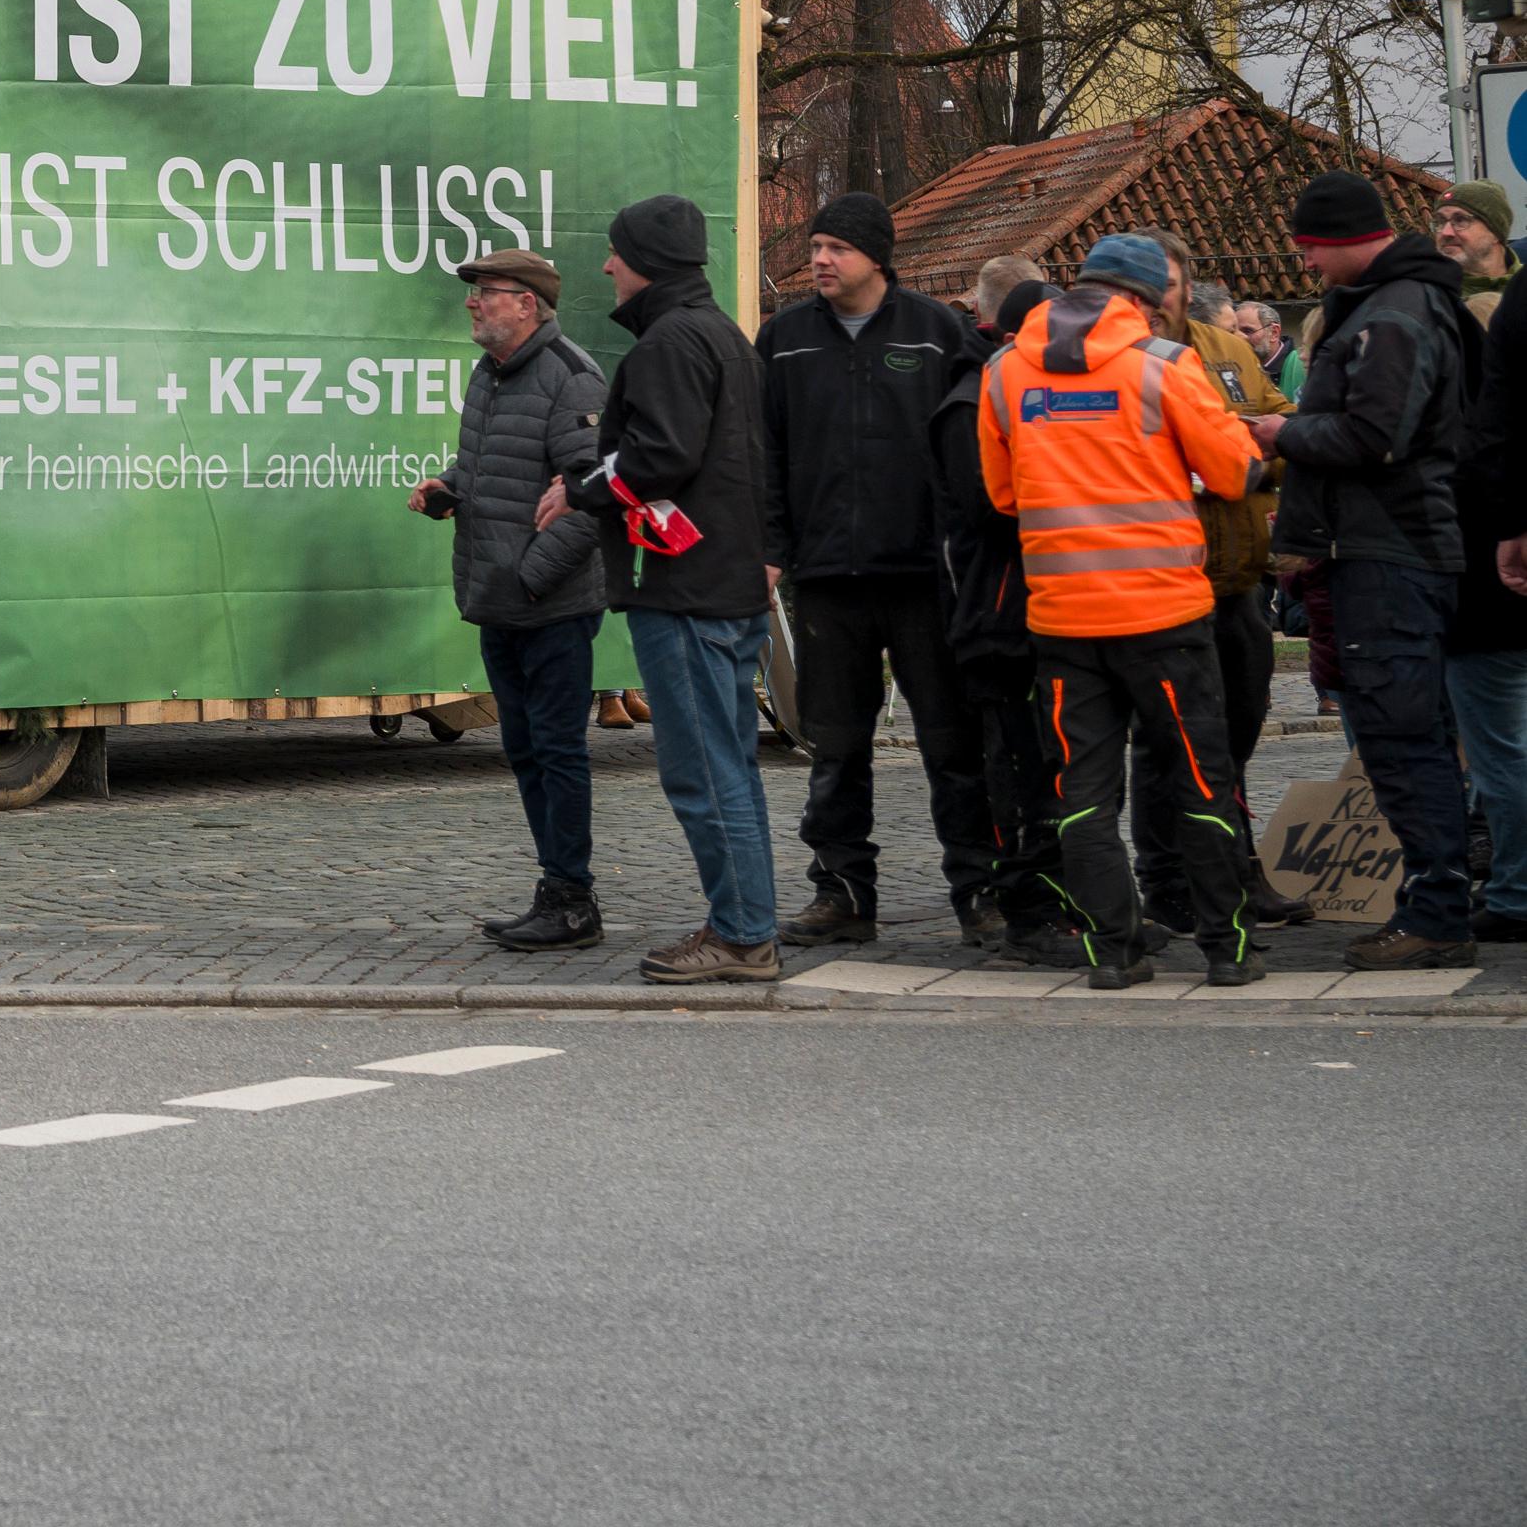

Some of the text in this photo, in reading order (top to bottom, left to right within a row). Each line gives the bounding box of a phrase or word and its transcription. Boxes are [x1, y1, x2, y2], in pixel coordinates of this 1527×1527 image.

[0, 152, 127, 269] IST
[156, 156, 554, 274] SCHLUSS!
[158, 373, 187, 414] +
[27, 443, 229, 491] heimische
[1273, 823, 1404, 892] Waffen
